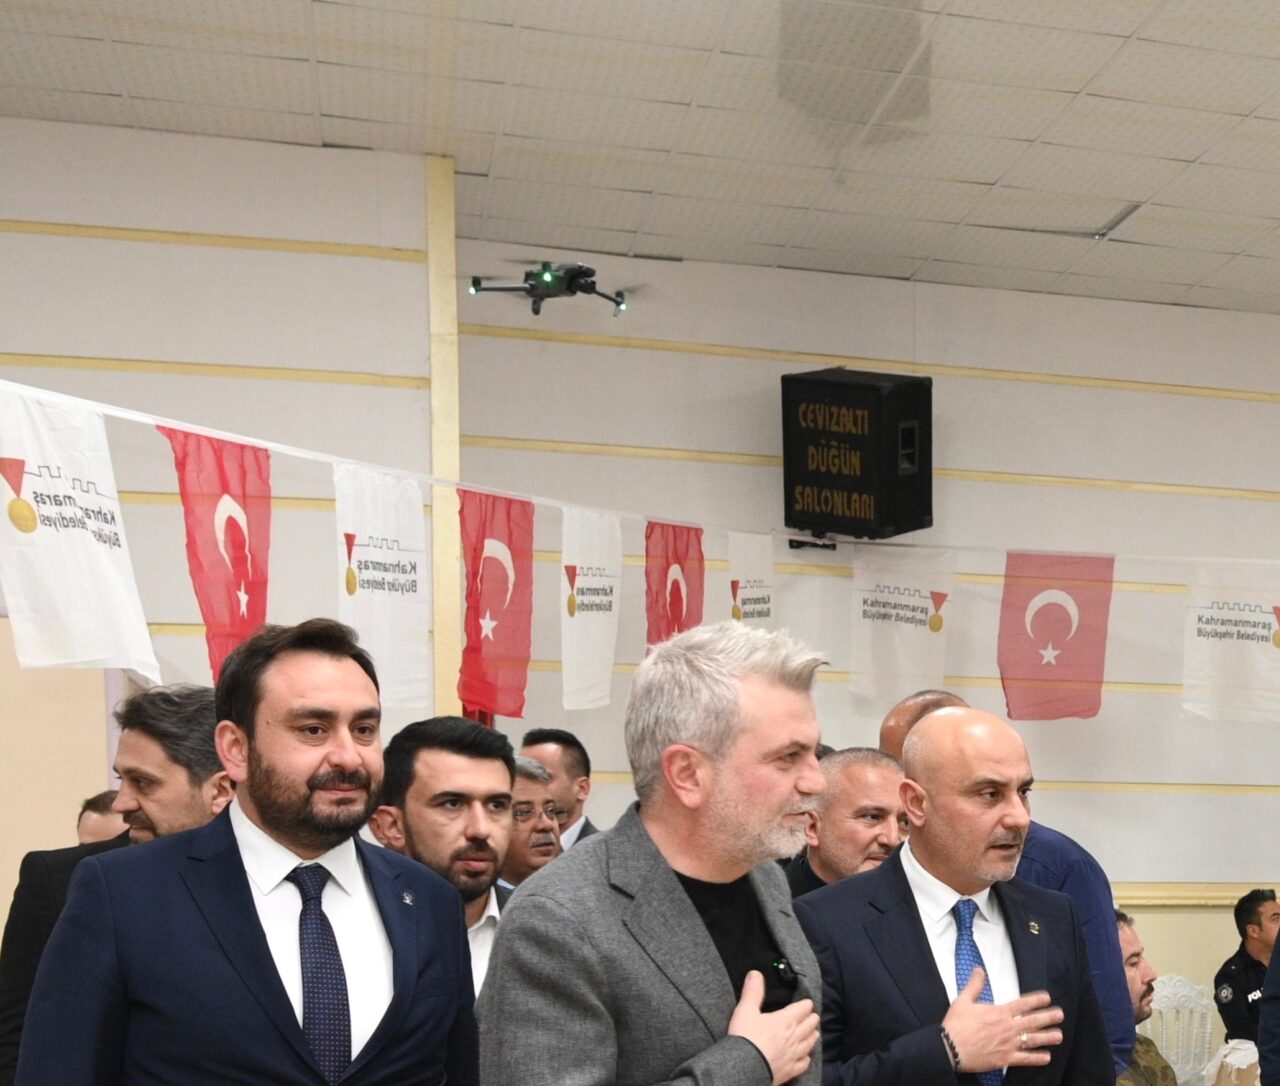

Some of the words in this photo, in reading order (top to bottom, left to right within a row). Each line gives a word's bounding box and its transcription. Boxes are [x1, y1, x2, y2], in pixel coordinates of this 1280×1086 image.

[808, 439, 861, 476] DÜĞÜN
[795, 485, 875, 520] SALONLARI
[1197, 614, 1272, 632] Kahramanmaraş
[1236, 630, 1271, 643] Belediyesi
[1247, 987, 1263, 1003] POL
